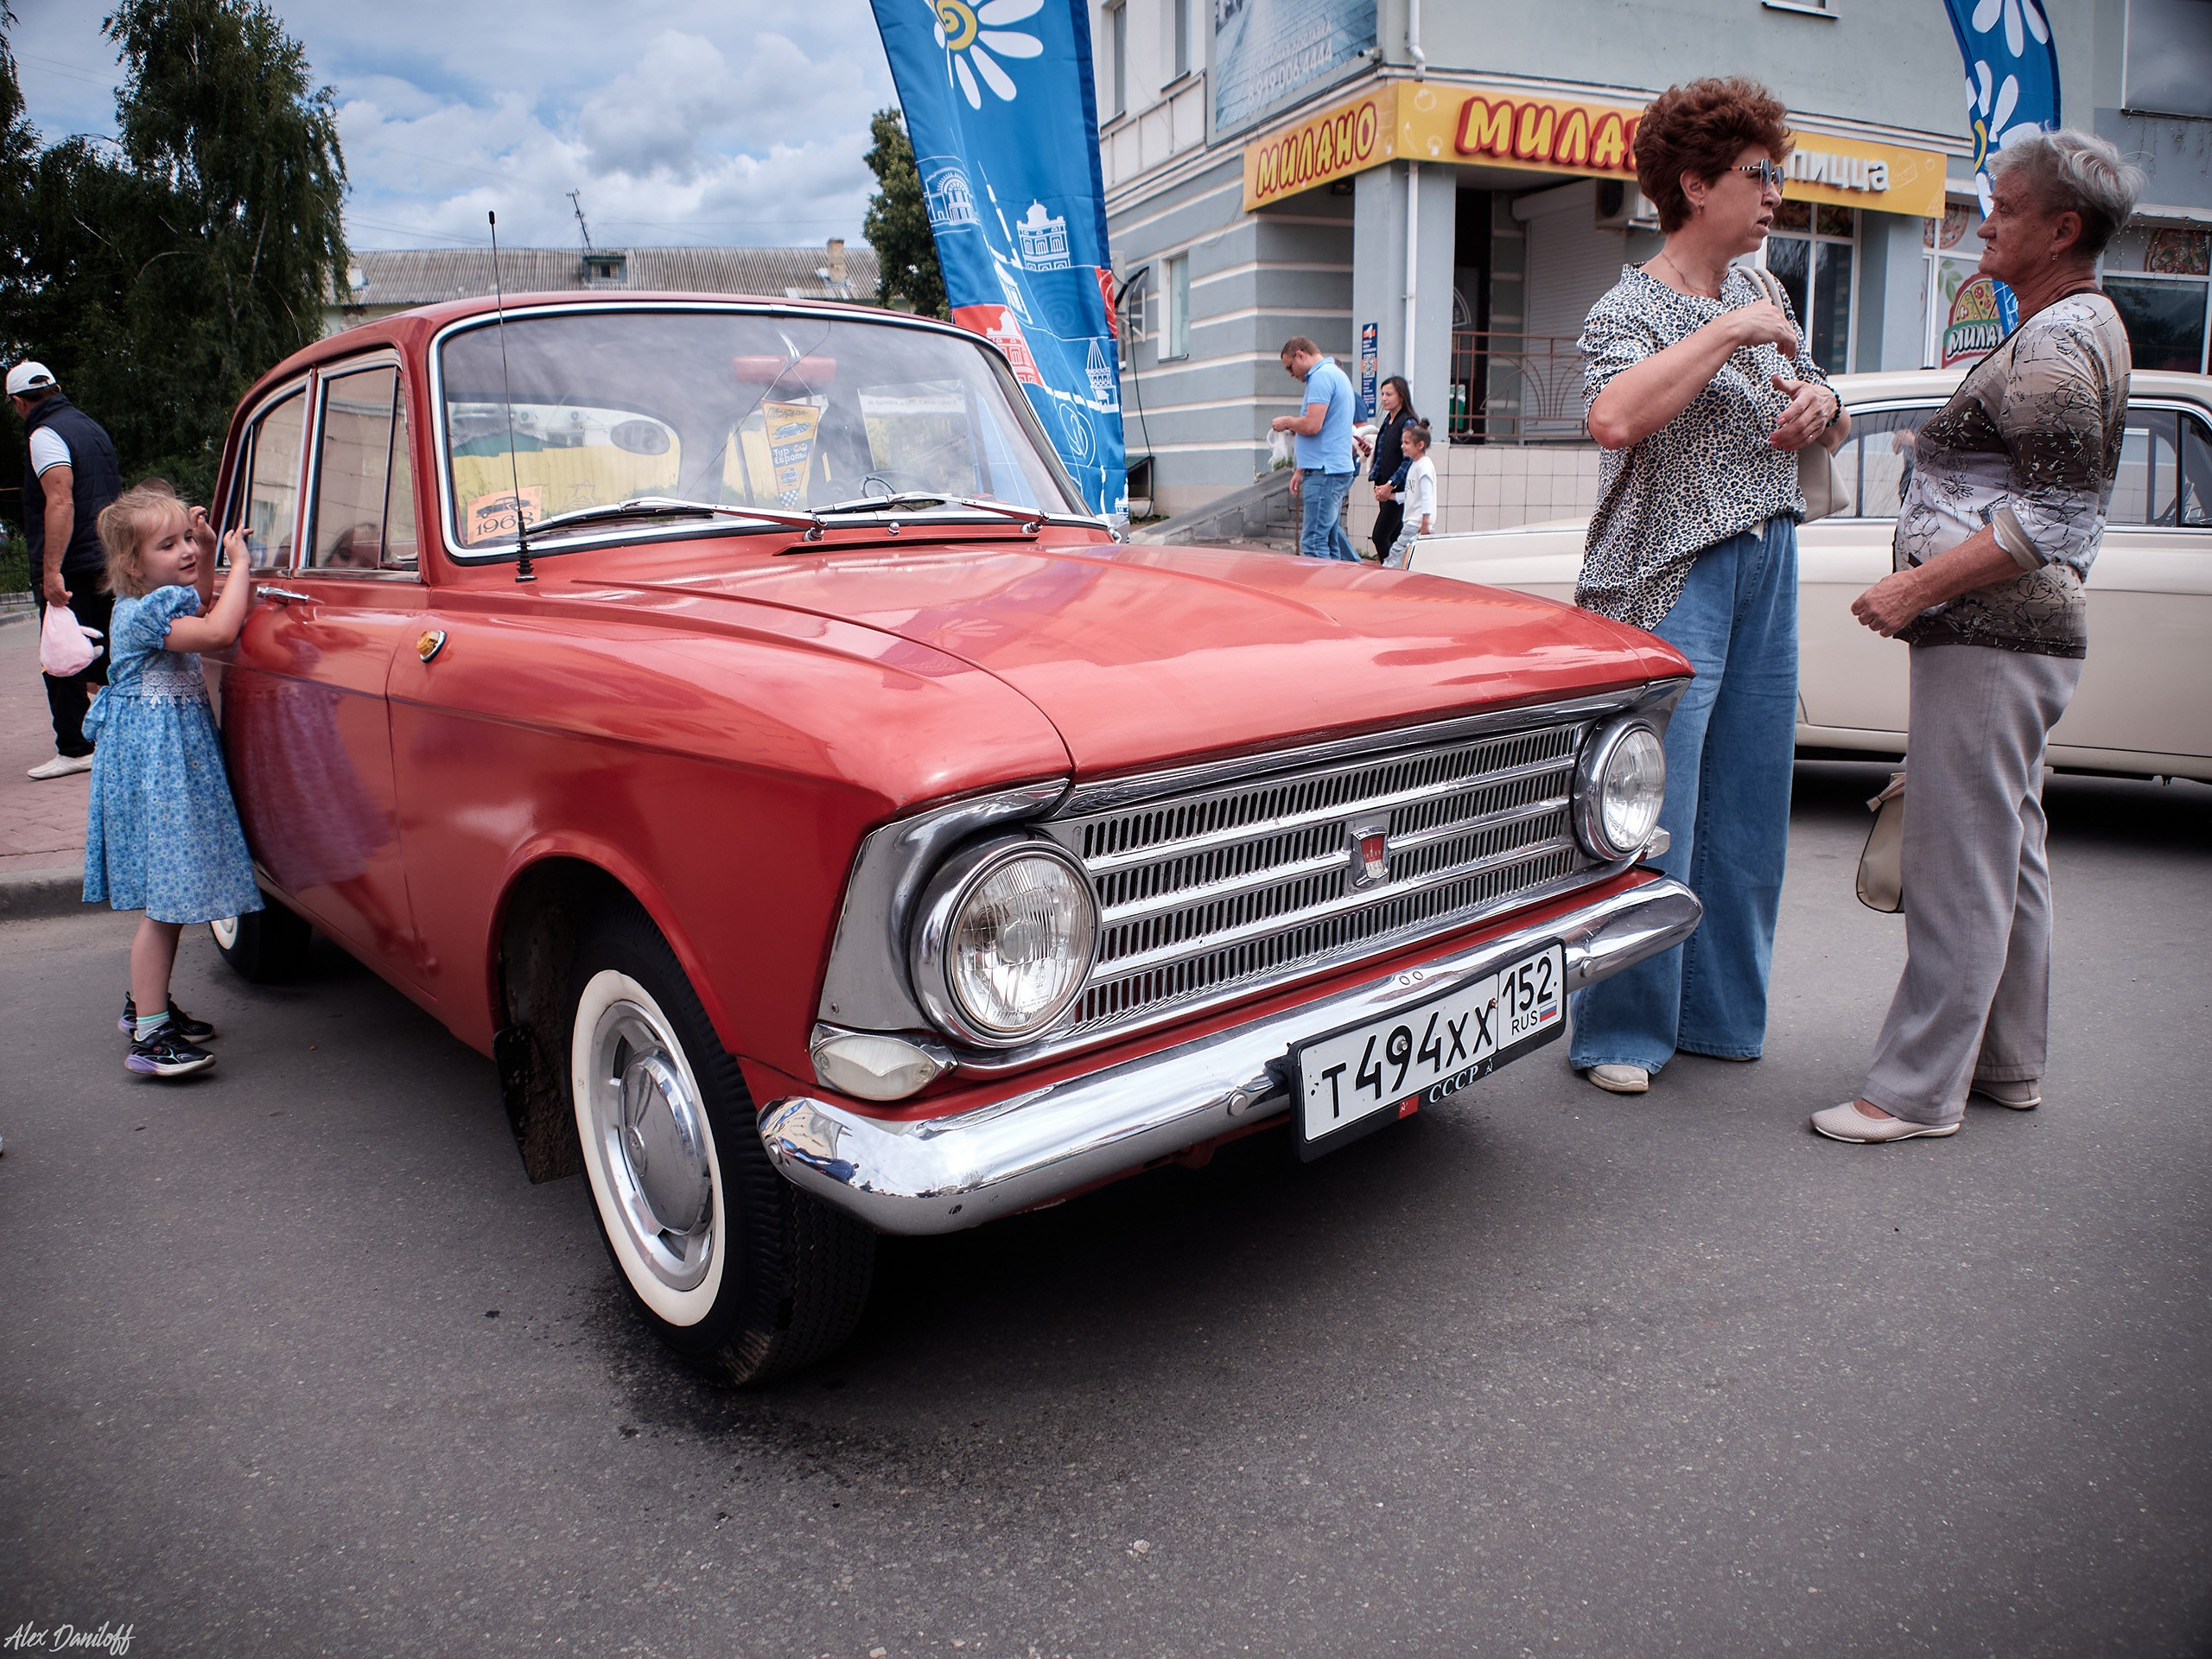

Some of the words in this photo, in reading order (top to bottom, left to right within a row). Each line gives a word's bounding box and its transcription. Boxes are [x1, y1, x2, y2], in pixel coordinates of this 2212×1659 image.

[1256, 101, 1377, 199] МИЛАНО
[1784, 149, 1891, 193] пицца
[1322, 1000, 1495, 1119] Т494ХХ
[1502, 956, 1553, 1018] 152
[1511, 1010, 1538, 1036] RUS
[1428, 1065, 1479, 1104] СССР
